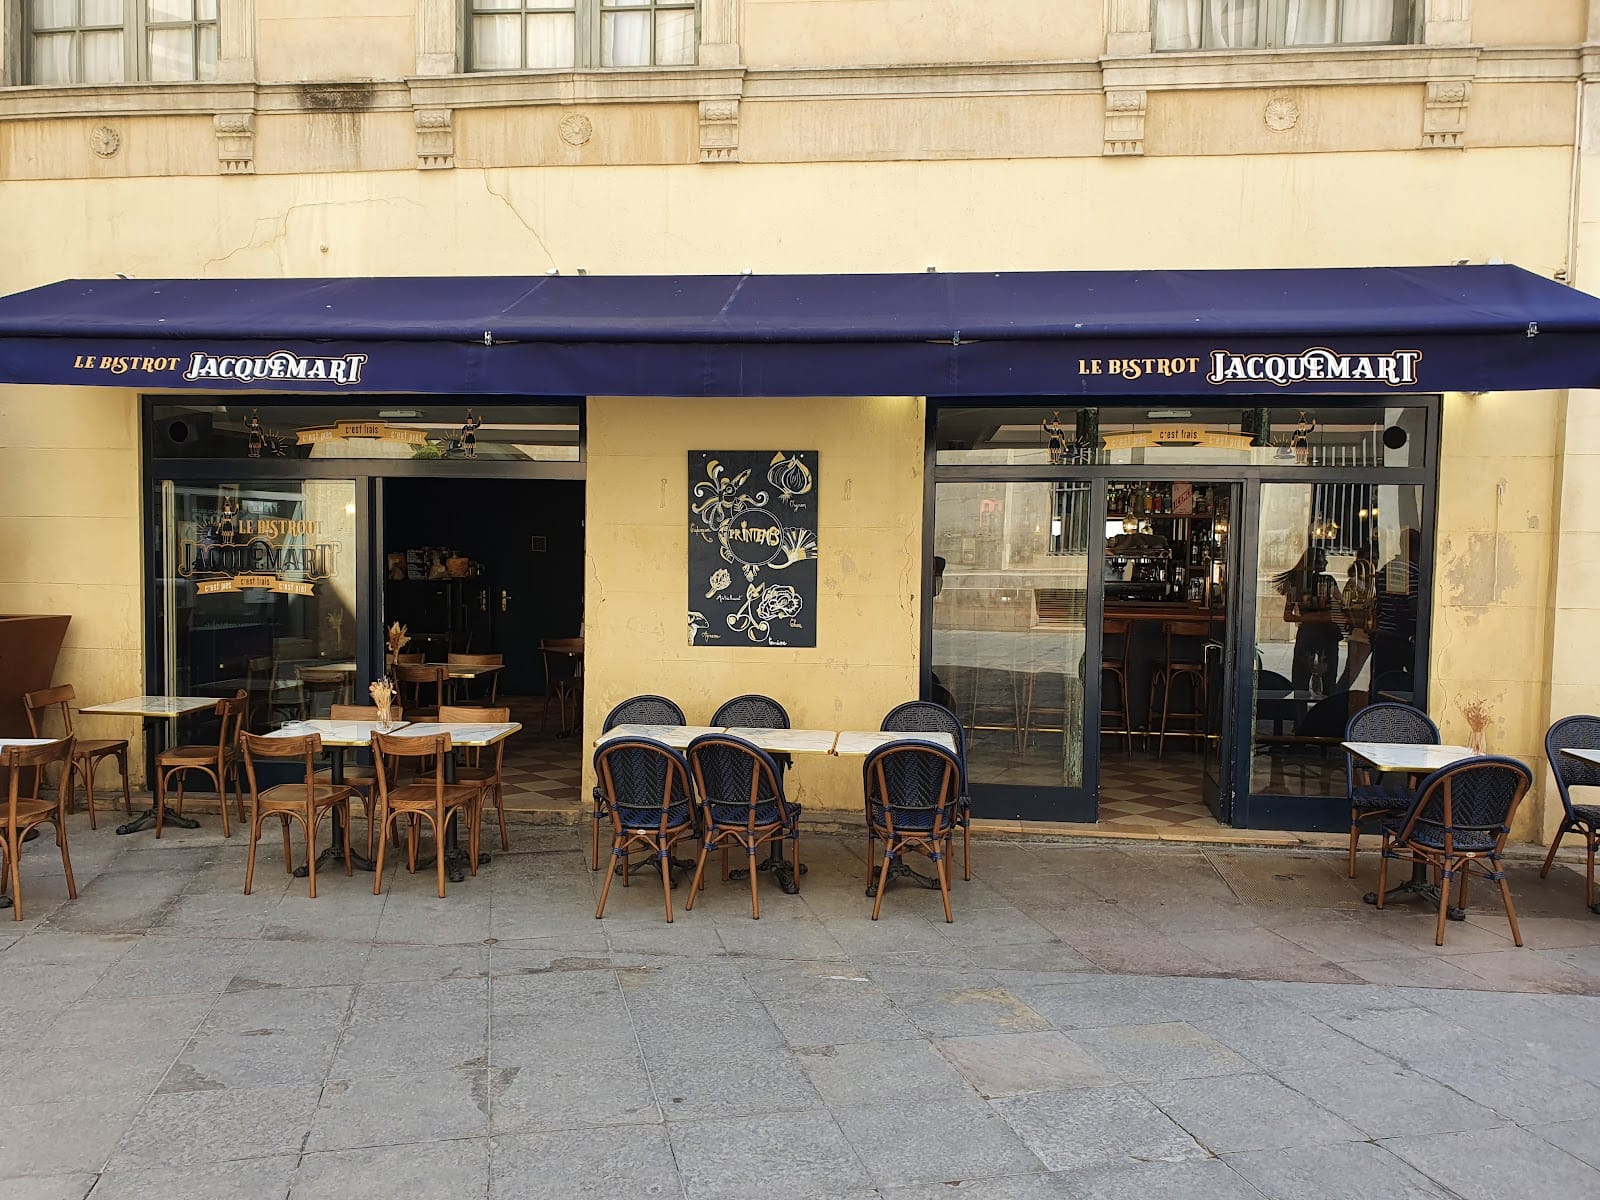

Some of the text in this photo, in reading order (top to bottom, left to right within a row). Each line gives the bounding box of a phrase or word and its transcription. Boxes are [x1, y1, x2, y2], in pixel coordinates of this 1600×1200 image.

[73, 351, 366, 385] LE BISTROT JACQUEMART
[1078, 348, 1421, 385] LE BISTROT JACQUEMART
[1159, 430, 1178, 439] c'est
[1180, 429, 1198, 439] frais
[238, 519, 317, 539] LE BISTROT
[178, 538, 333, 579] JACQUEMART
